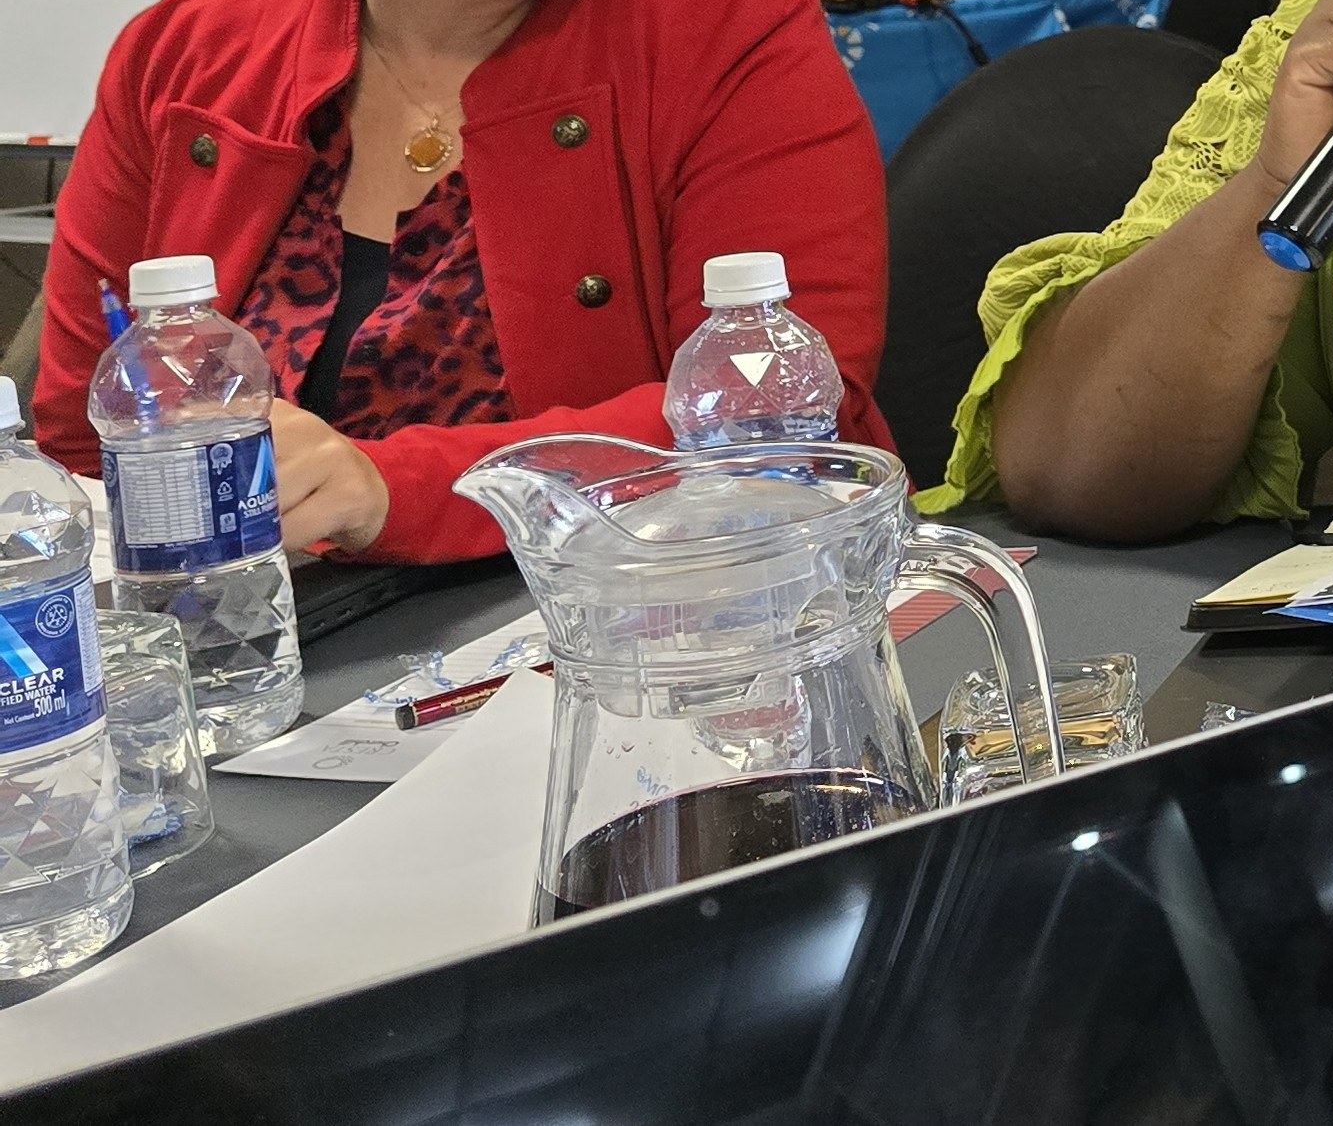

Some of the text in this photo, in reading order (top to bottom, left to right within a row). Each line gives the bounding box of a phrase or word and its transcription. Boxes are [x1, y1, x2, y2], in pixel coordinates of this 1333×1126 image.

[25, 684, 57, 701] WATER
[34, 695, 52, 717] 500
[54, 688, 67, 712] ml
